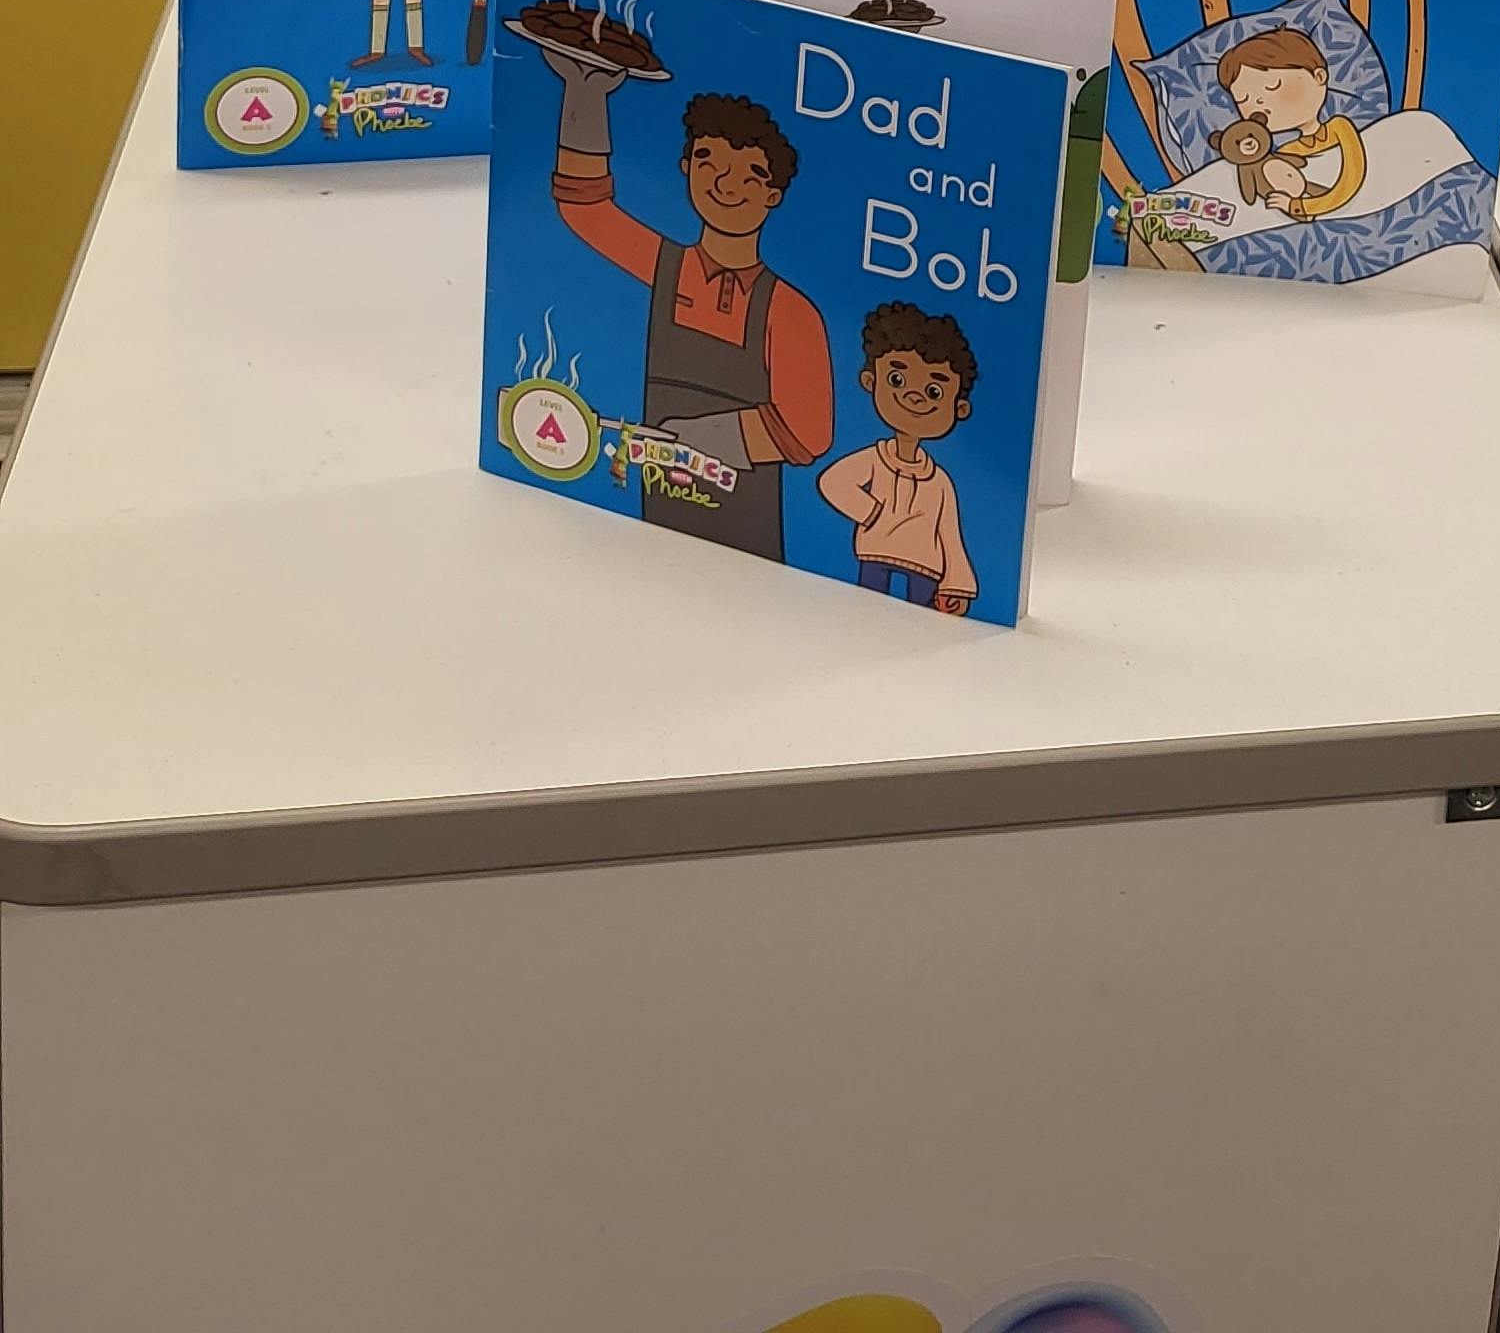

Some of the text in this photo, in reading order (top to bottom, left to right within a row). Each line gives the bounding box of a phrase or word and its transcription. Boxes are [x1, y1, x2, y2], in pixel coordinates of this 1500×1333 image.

[240, 96, 273, 122] A
[340, 83, 447, 113] PHONICS
[795, 40, 953, 151] Dad
[353, 108, 433, 138] Phoebe
[908, 162, 998, 210] and
[1131, 195, 1233, 223] PHONICS
[1142, 212, 1219, 246] Phoebe
[860, 196, 1019, 304] Bob
[539, 398, 563, 412] LEVEL
[535, 412, 567, 444] A
[630, 440, 736, 488] PHONICS
[642, 462, 722, 509] Phoebe
